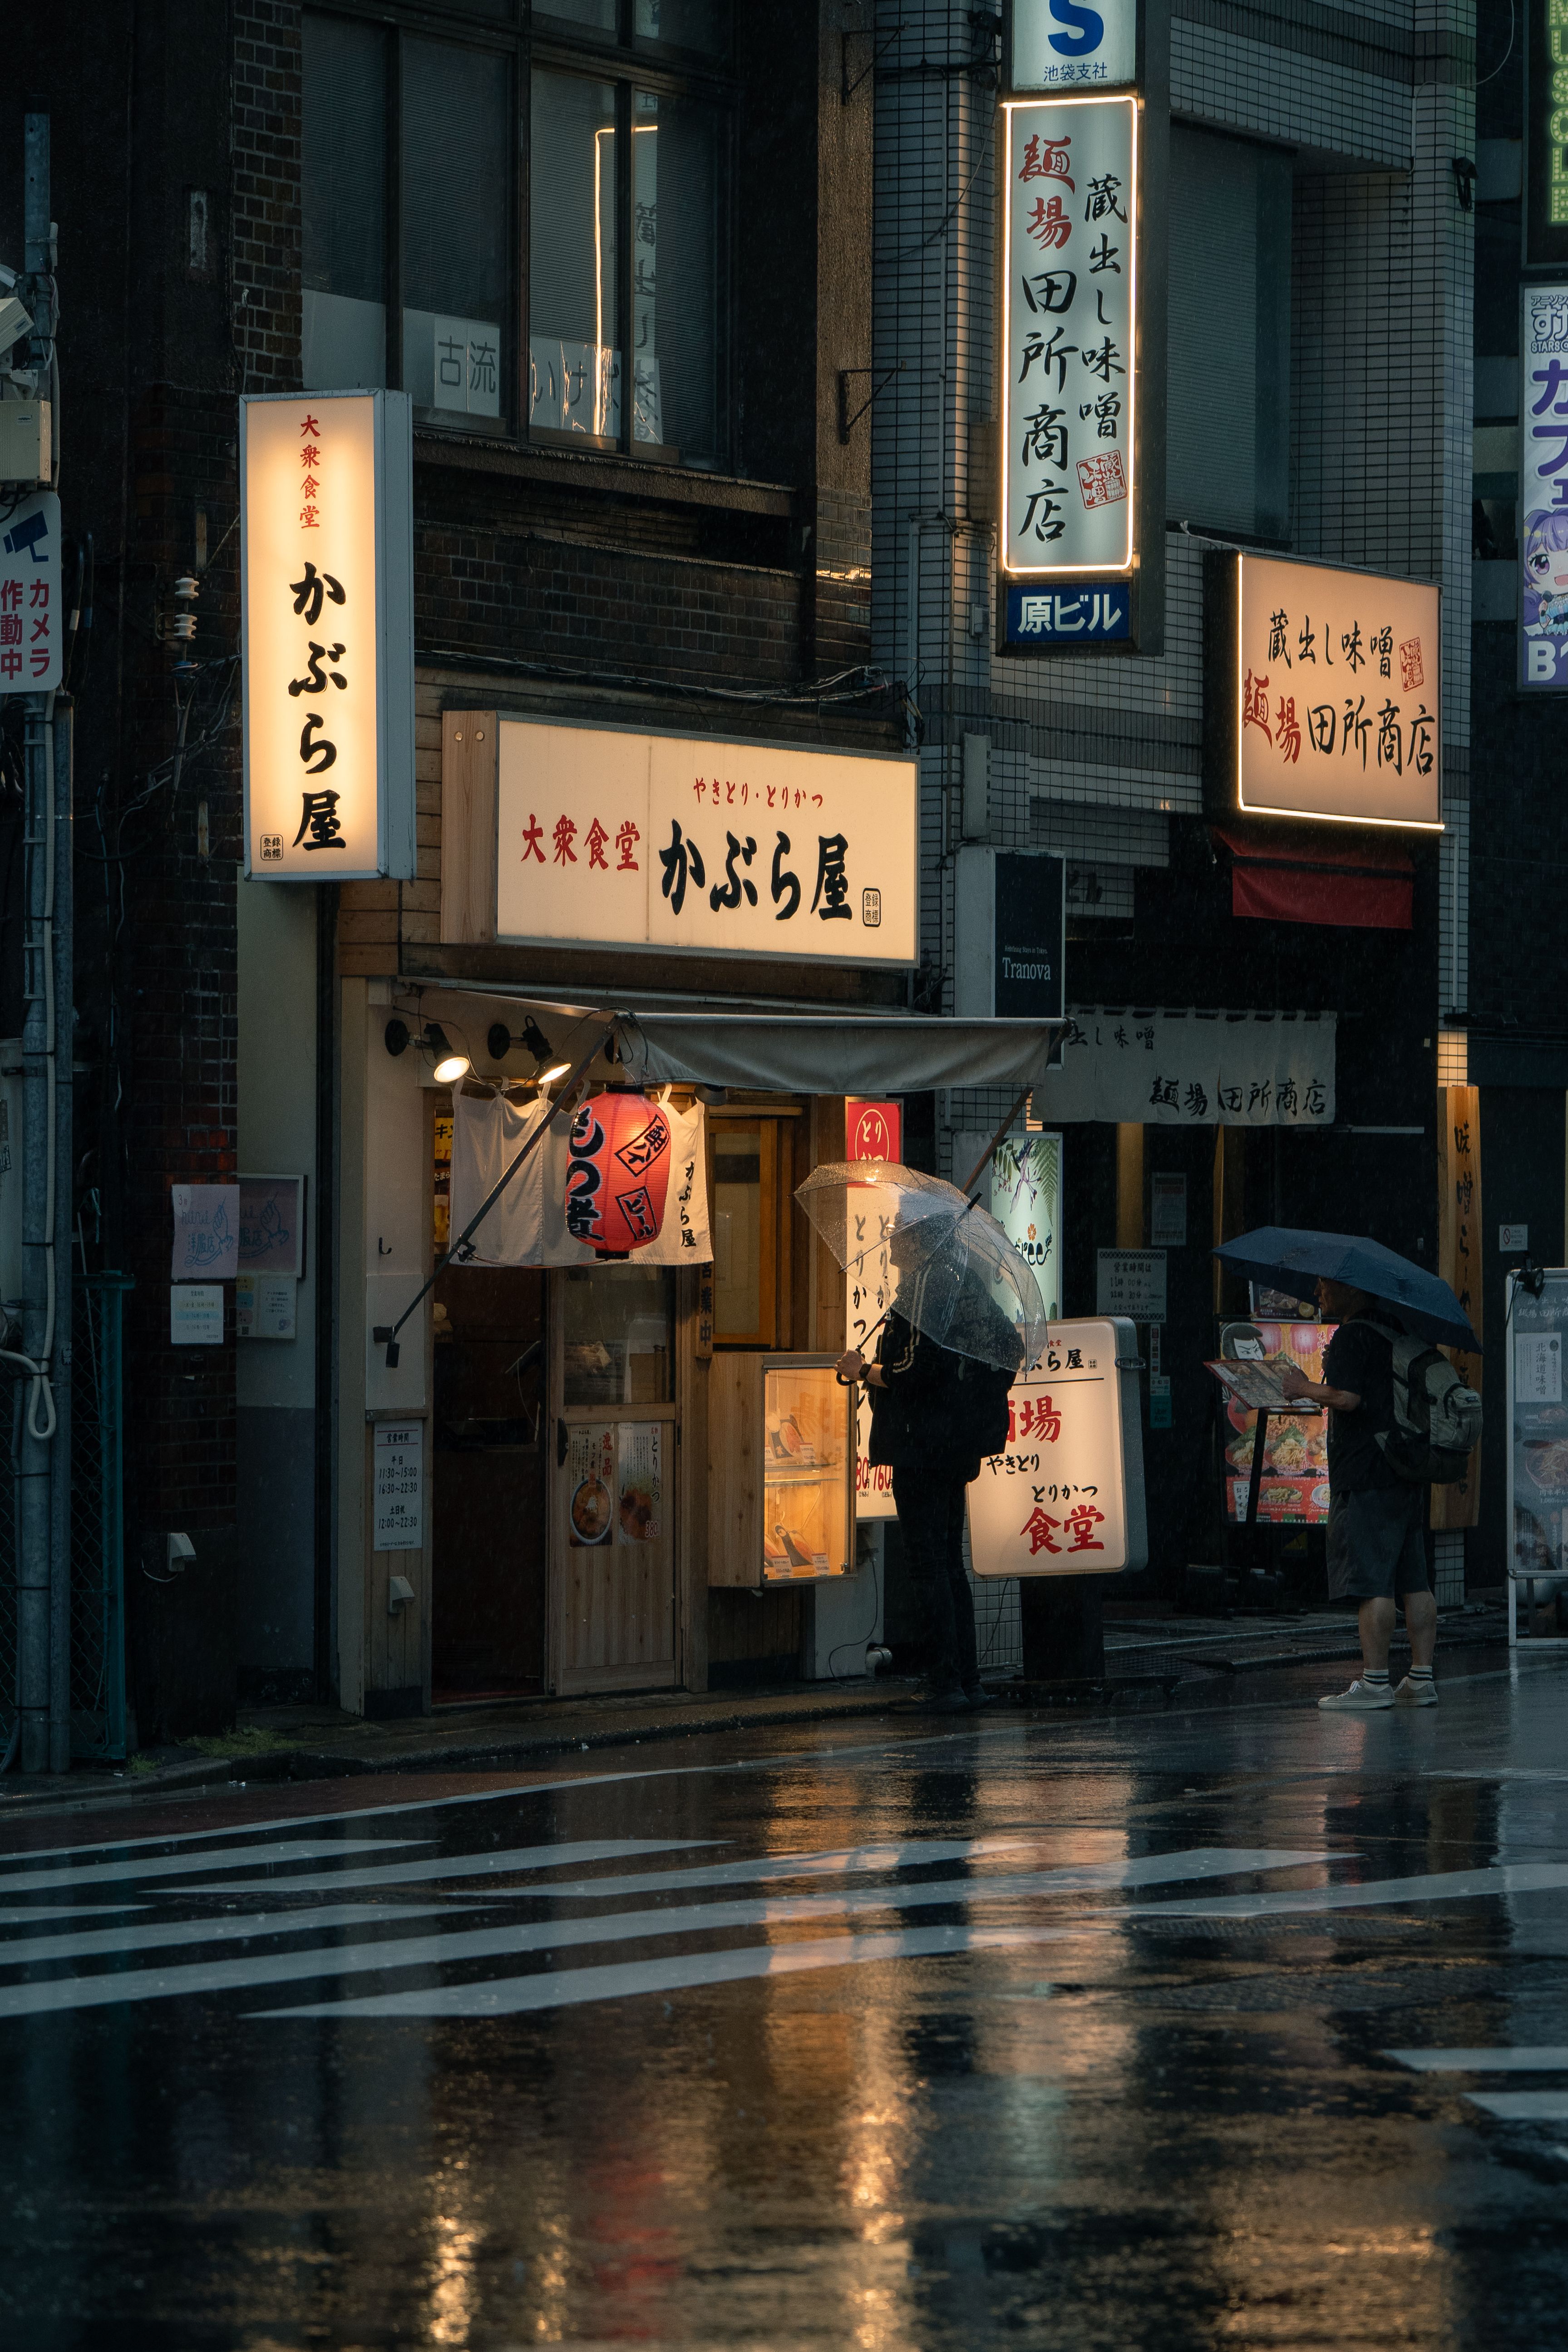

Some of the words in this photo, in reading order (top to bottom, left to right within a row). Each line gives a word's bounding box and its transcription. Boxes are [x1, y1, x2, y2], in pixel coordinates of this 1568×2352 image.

[1044, 62, 1108, 82] 池袋支社
[1079, 173, 1128, 440] 蔵出し味噌
[438, 335, 496, 394] 古流
[1018, 134, 1080, 544] 麺場田所商店
[299, 414, 321, 529] 大衆食堂
[0, 580, 23, 680] 作動中
[29, 578, 50, 678] カメラ
[1017, 593, 1122, 635] 原ビル
[1268, 607, 1393, 680] 蔵出し味噌
[288, 562, 347, 852] かぶら屋
[1242, 668, 1436, 777] 麺場田所商店
[693, 777, 823, 810] やきとり・とりかつ
[520, 813, 641, 871] 大衆食堂
[658, 818, 853, 921] かぶら屋
[1002, 957, 1051, 981] Tranova
[1149, 1075, 1326, 1117] 麺場田所商店
[862, 1119, 882, 1144] とり
[623, 1191, 654, 1238] ビール
[678, 1161, 697, 1248] かぶら屋
[387, 1433, 409, 1443] 営業時間
[391, 1456, 404, 1465] 平日
[986, 1454, 1040, 1475] やきとり
[651, 1435, 660, 1503] とりかつ
[1031, 1484, 1098, 1503] とりかつ
[1019, 1504, 1105, 1556] 食堂
